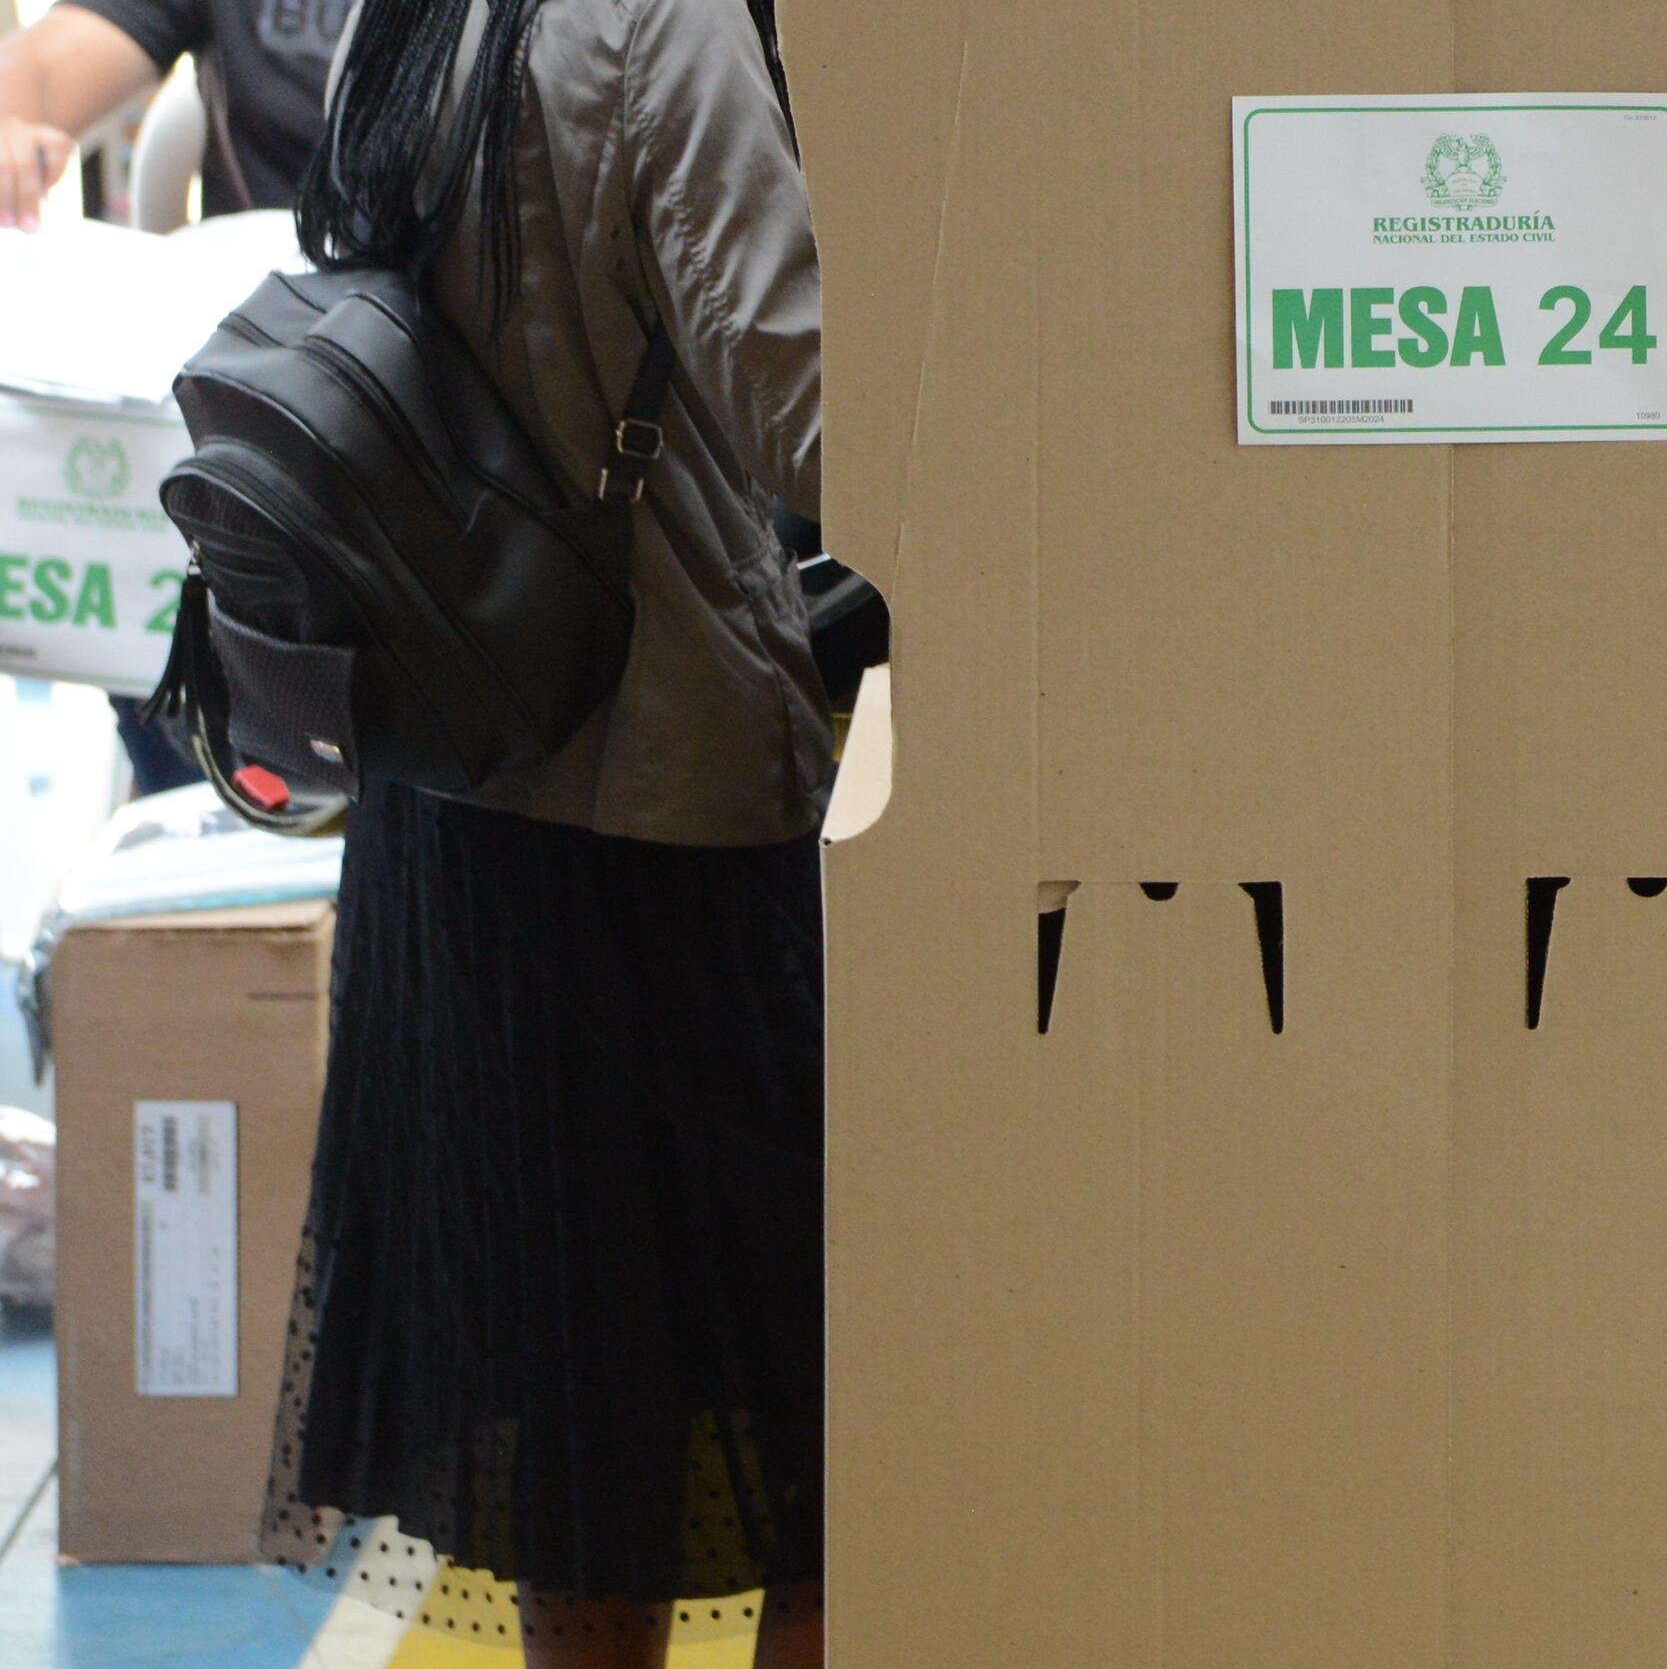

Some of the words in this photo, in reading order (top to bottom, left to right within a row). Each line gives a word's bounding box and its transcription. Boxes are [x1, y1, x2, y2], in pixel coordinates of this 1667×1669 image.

[1373, 211, 1555, 232] REGISTRADURÍA
[1373, 234, 1436, 244] NACIONAL
[1440, 234, 1466, 243] DEL
[1470, 233, 1519, 243] ESTADO
[1523, 232, 1556, 242] CIVIL
[1272, 286, 1506, 369] MESA
[1538, 285, 1657, 365] 24
[0, 553, 117, 630] ESA
[146, 568, 187, 634] 2
